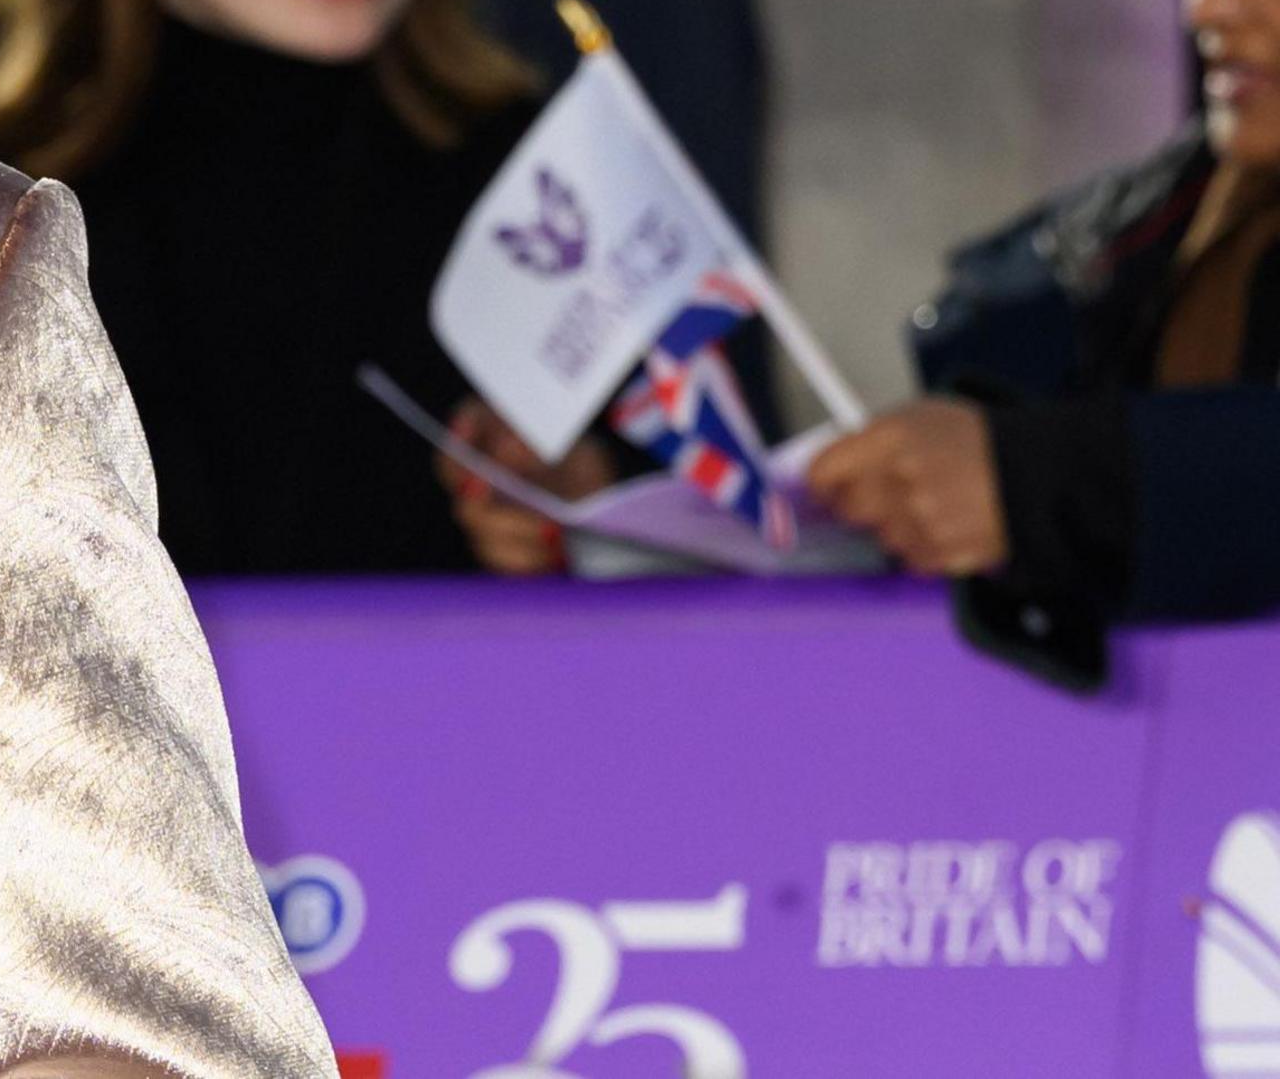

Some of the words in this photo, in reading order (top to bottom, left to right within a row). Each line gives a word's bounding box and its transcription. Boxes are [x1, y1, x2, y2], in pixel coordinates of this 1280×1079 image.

[826, 841, 1019, 901] PRIDE
[1020, 838, 1124, 900] OF
[818, 899, 1113, 967] BRITAIN
[448, 882, 748, 1079] 25
